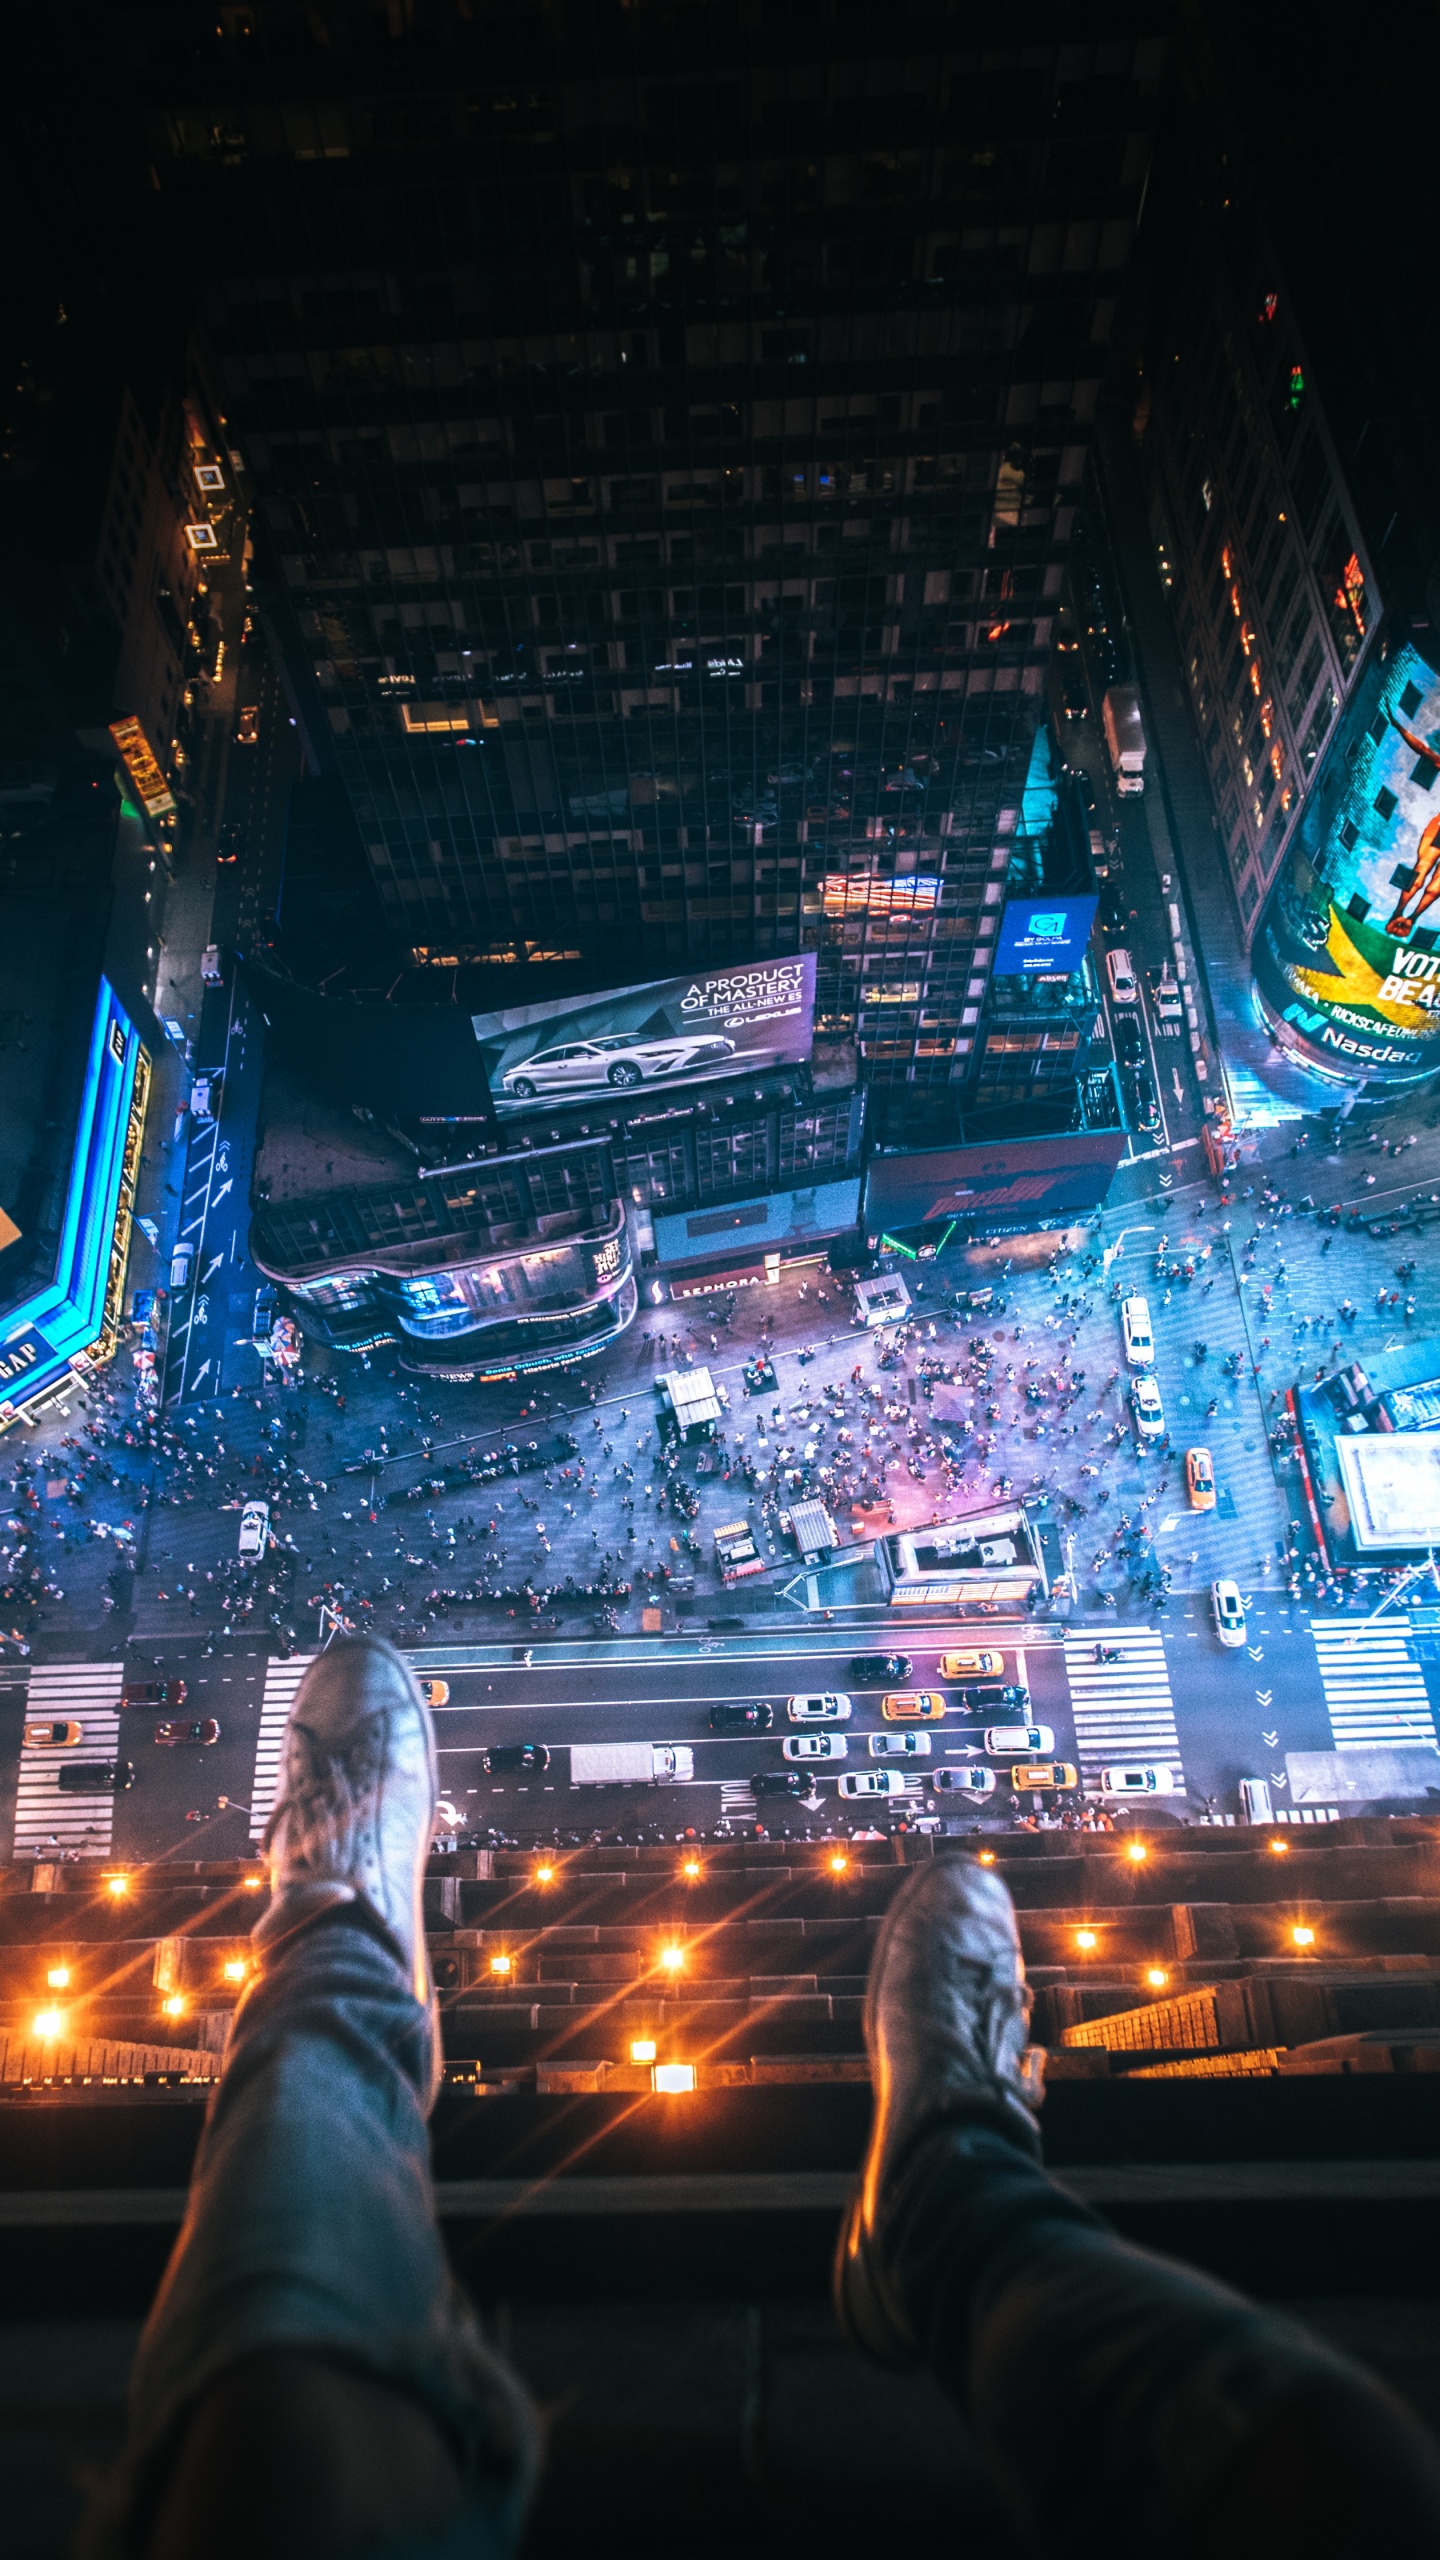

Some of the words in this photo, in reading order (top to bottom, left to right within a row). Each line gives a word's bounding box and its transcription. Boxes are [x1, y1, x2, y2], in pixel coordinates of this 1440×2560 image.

[1392, 947, 1440, 983] VOT
[680, 995, 708, 1009] OF
[713, 976, 803, 1004] MASTERY
[687, 984, 701, 997] A
[705, 963, 804, 993] PRODUCT
[708, 1005, 730, 1016] THE
[733, 995, 785, 1012] ALL-NEW
[788, 991, 803, 1003] ES
[745, 1007, 802, 1023] LEXUS
[1321, 1027, 1423, 1065] Nasdaq
[985, 1225, 1028, 1235] CITIZEN
[682, 1276, 760, 1298] SEPHORA
[439, 1372, 475, 1380] NEWS
